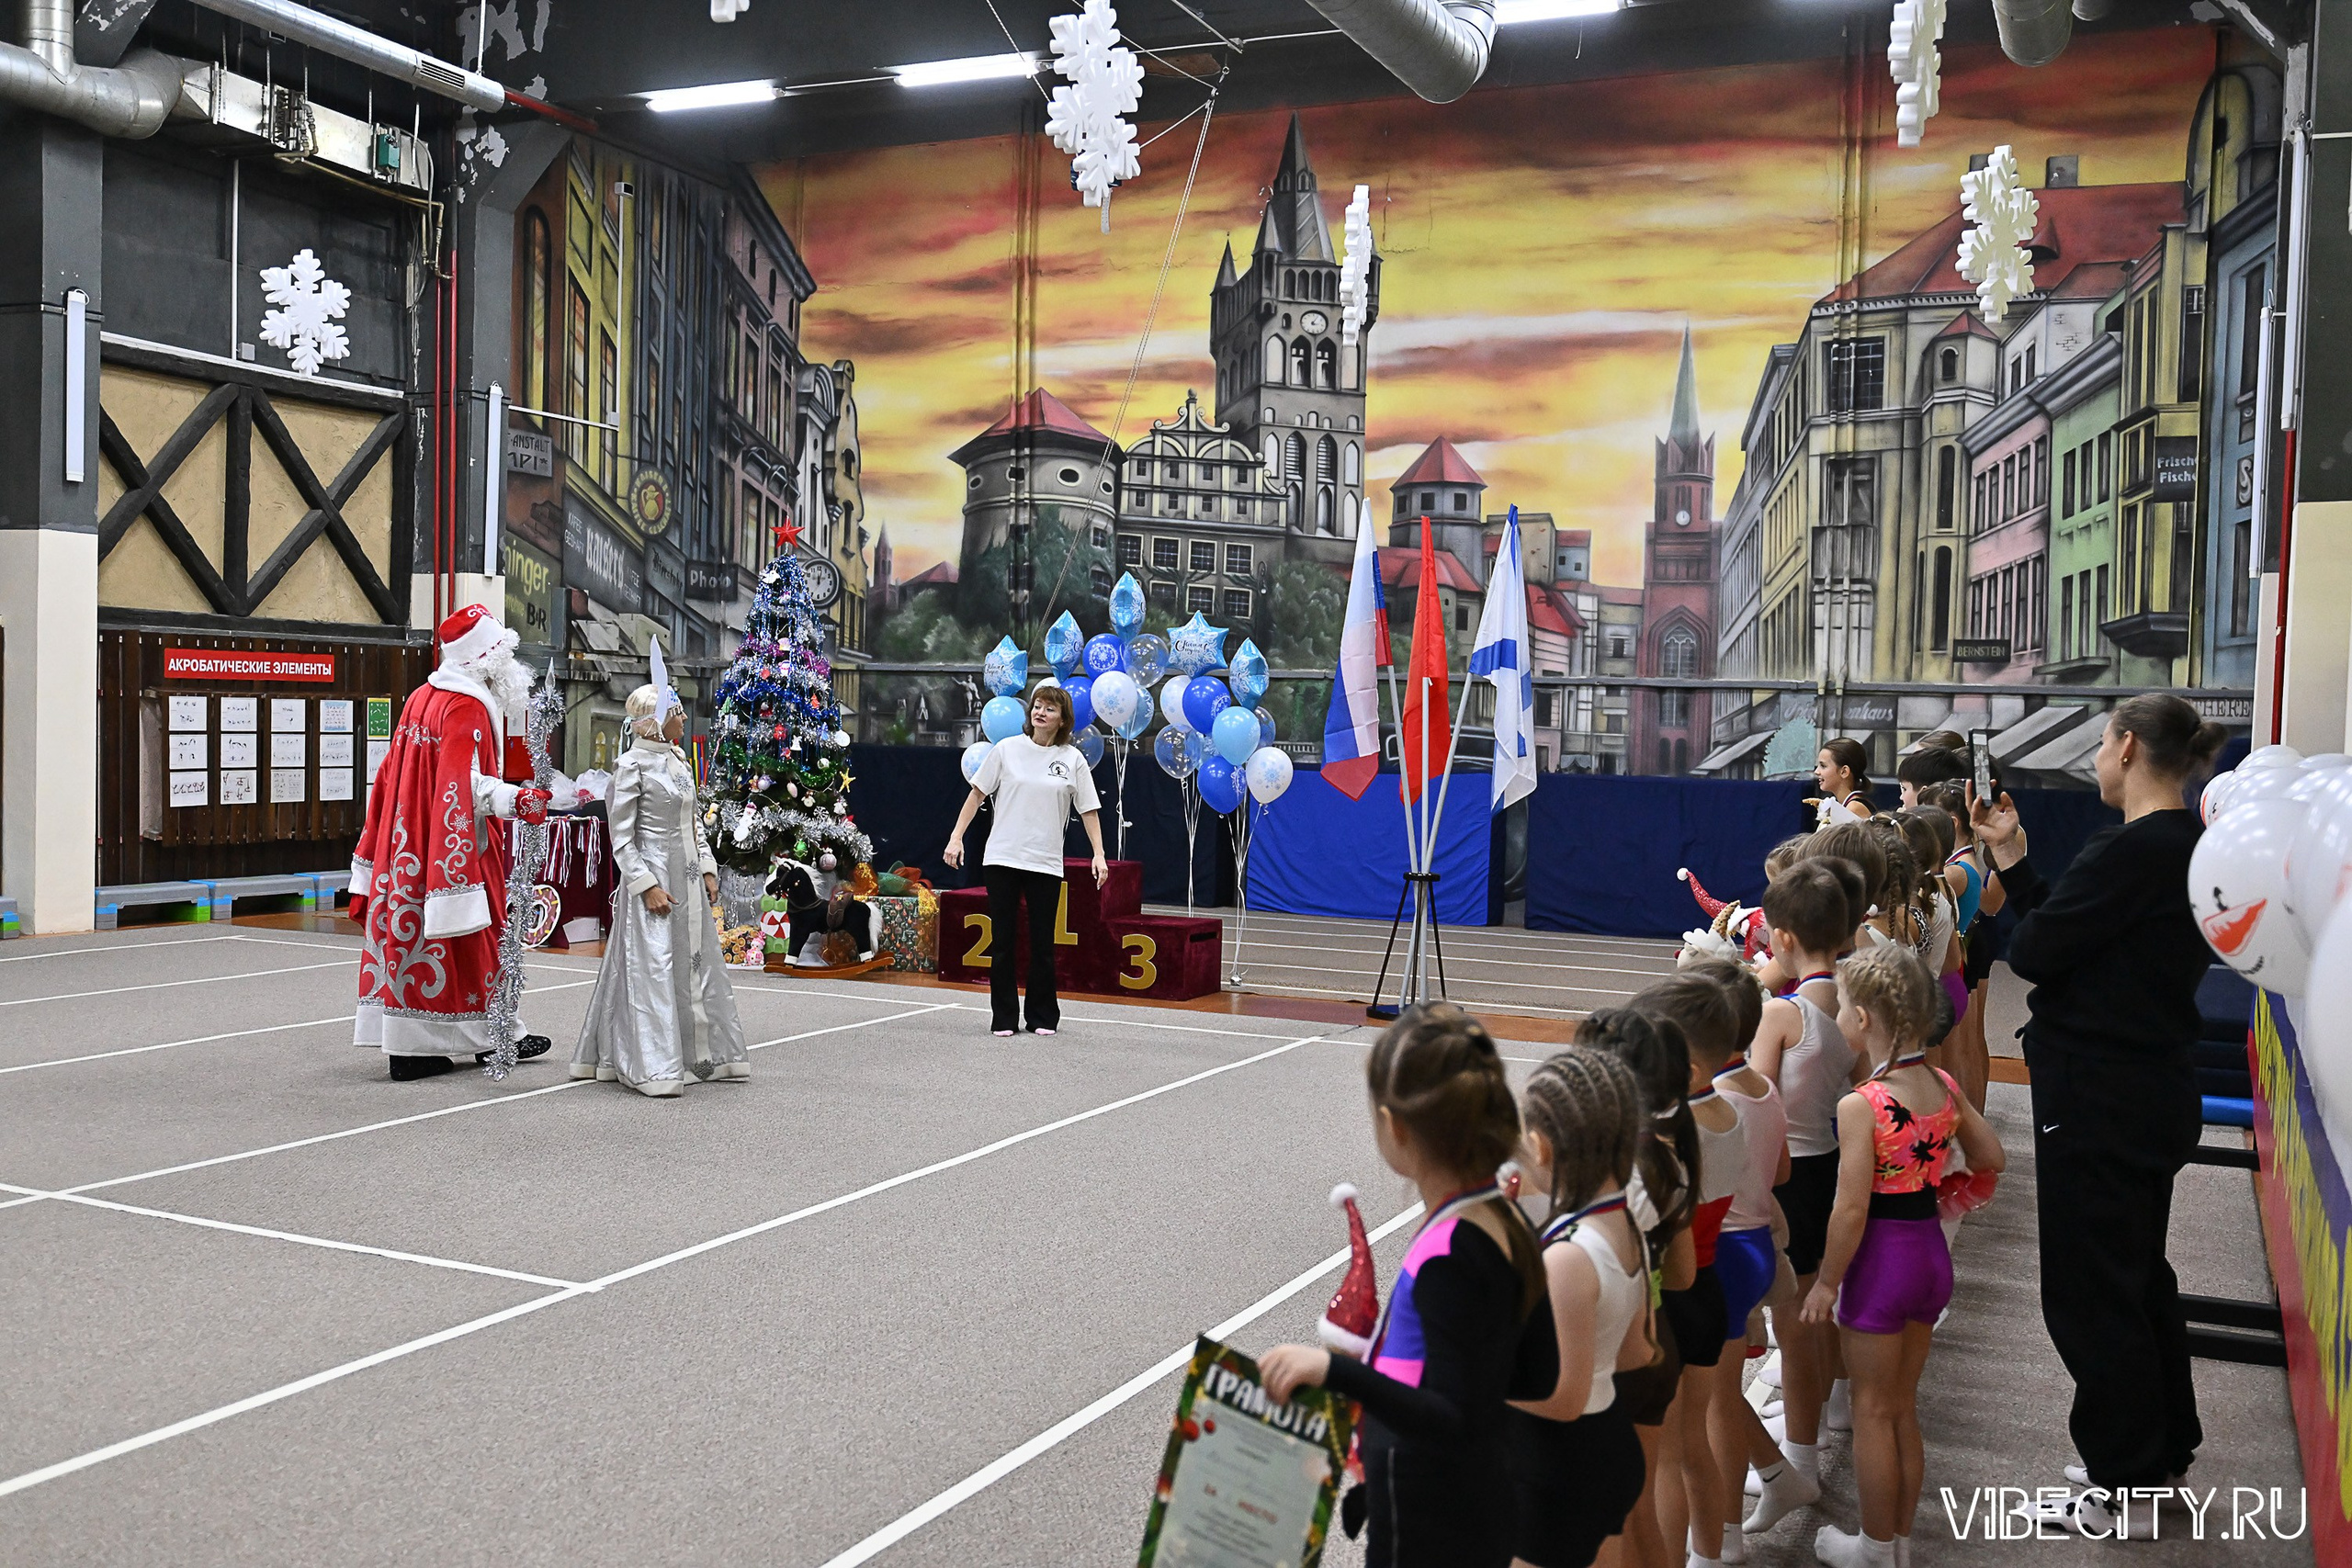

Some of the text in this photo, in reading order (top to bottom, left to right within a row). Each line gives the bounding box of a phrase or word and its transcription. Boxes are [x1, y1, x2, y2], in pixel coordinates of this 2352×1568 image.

[690, 570, 731, 588] Photo
[1957, 646, 2006, 657] BERNSTEIN
[168, 658, 332, 676] АКРОБАТИЧЕСКИЕ ЭЛЕМЕНТЫ
[961, 913, 993, 968] 2
[1119, 933, 1158, 990] 3
